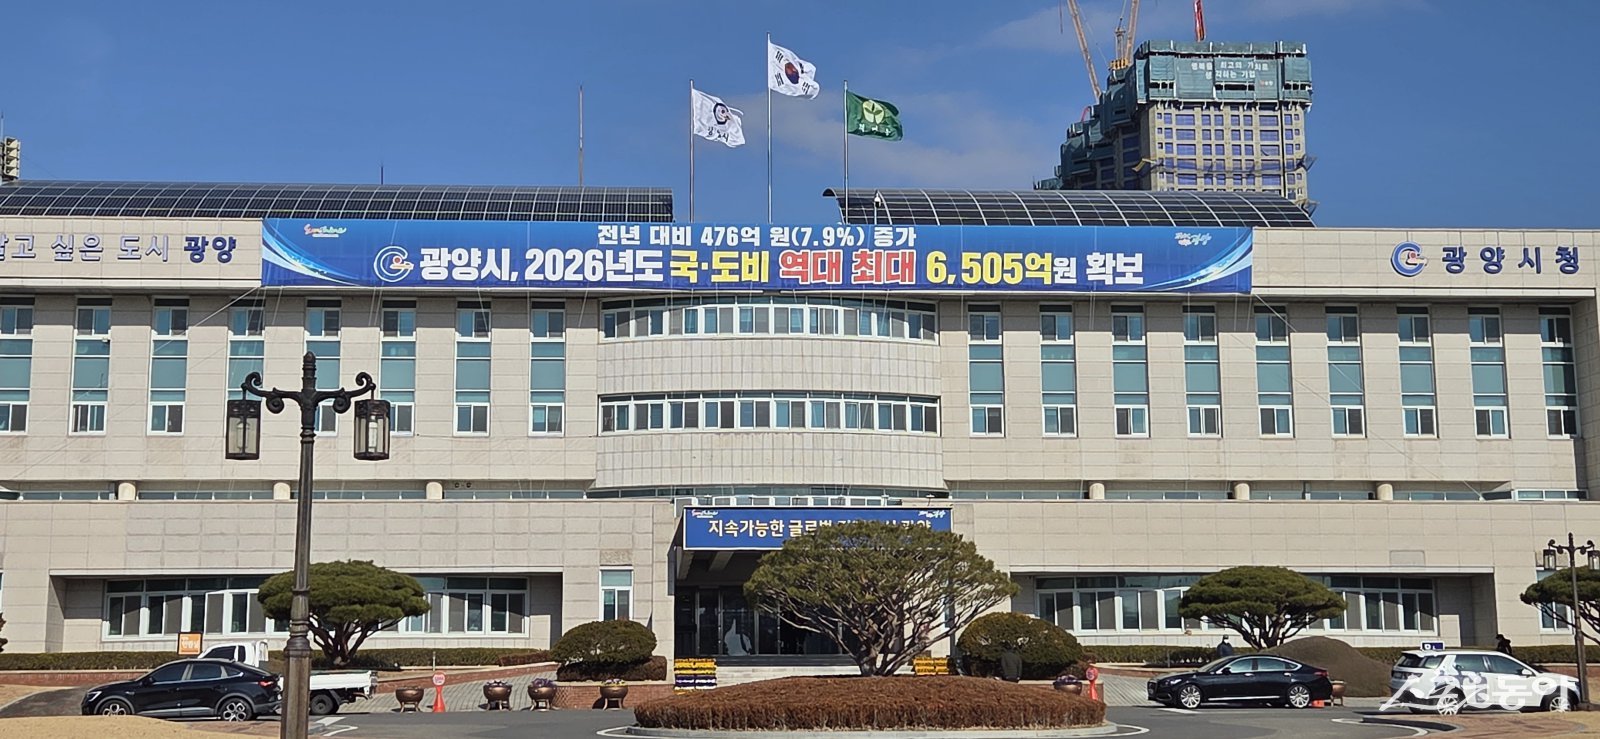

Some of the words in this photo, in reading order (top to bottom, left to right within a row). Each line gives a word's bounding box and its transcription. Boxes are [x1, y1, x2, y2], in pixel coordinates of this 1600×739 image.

[51, 234, 103, 261] 싶은
[117, 234, 168, 262] 도시
[184, 236, 236, 263] 광양
[598, 225, 640, 245] 전년
[650, 226, 692, 246] 대비
[701, 226, 760, 247] 476억
[770, 226, 865, 247] 원(7.9%)
[874, 226, 916, 247] 증가
[420, 248, 519, 282] 광양시,
[525, 248, 664, 282] 2026년도
[670, 250, 769, 283] 국·도비
[779, 249, 843, 285] 역대
[851, 249, 916, 285] 최대
[1086, 252, 1144, 285] 확보
[1442, 246, 1580, 274] 광양시청
[708, 519, 785, 538] 지속가능한
